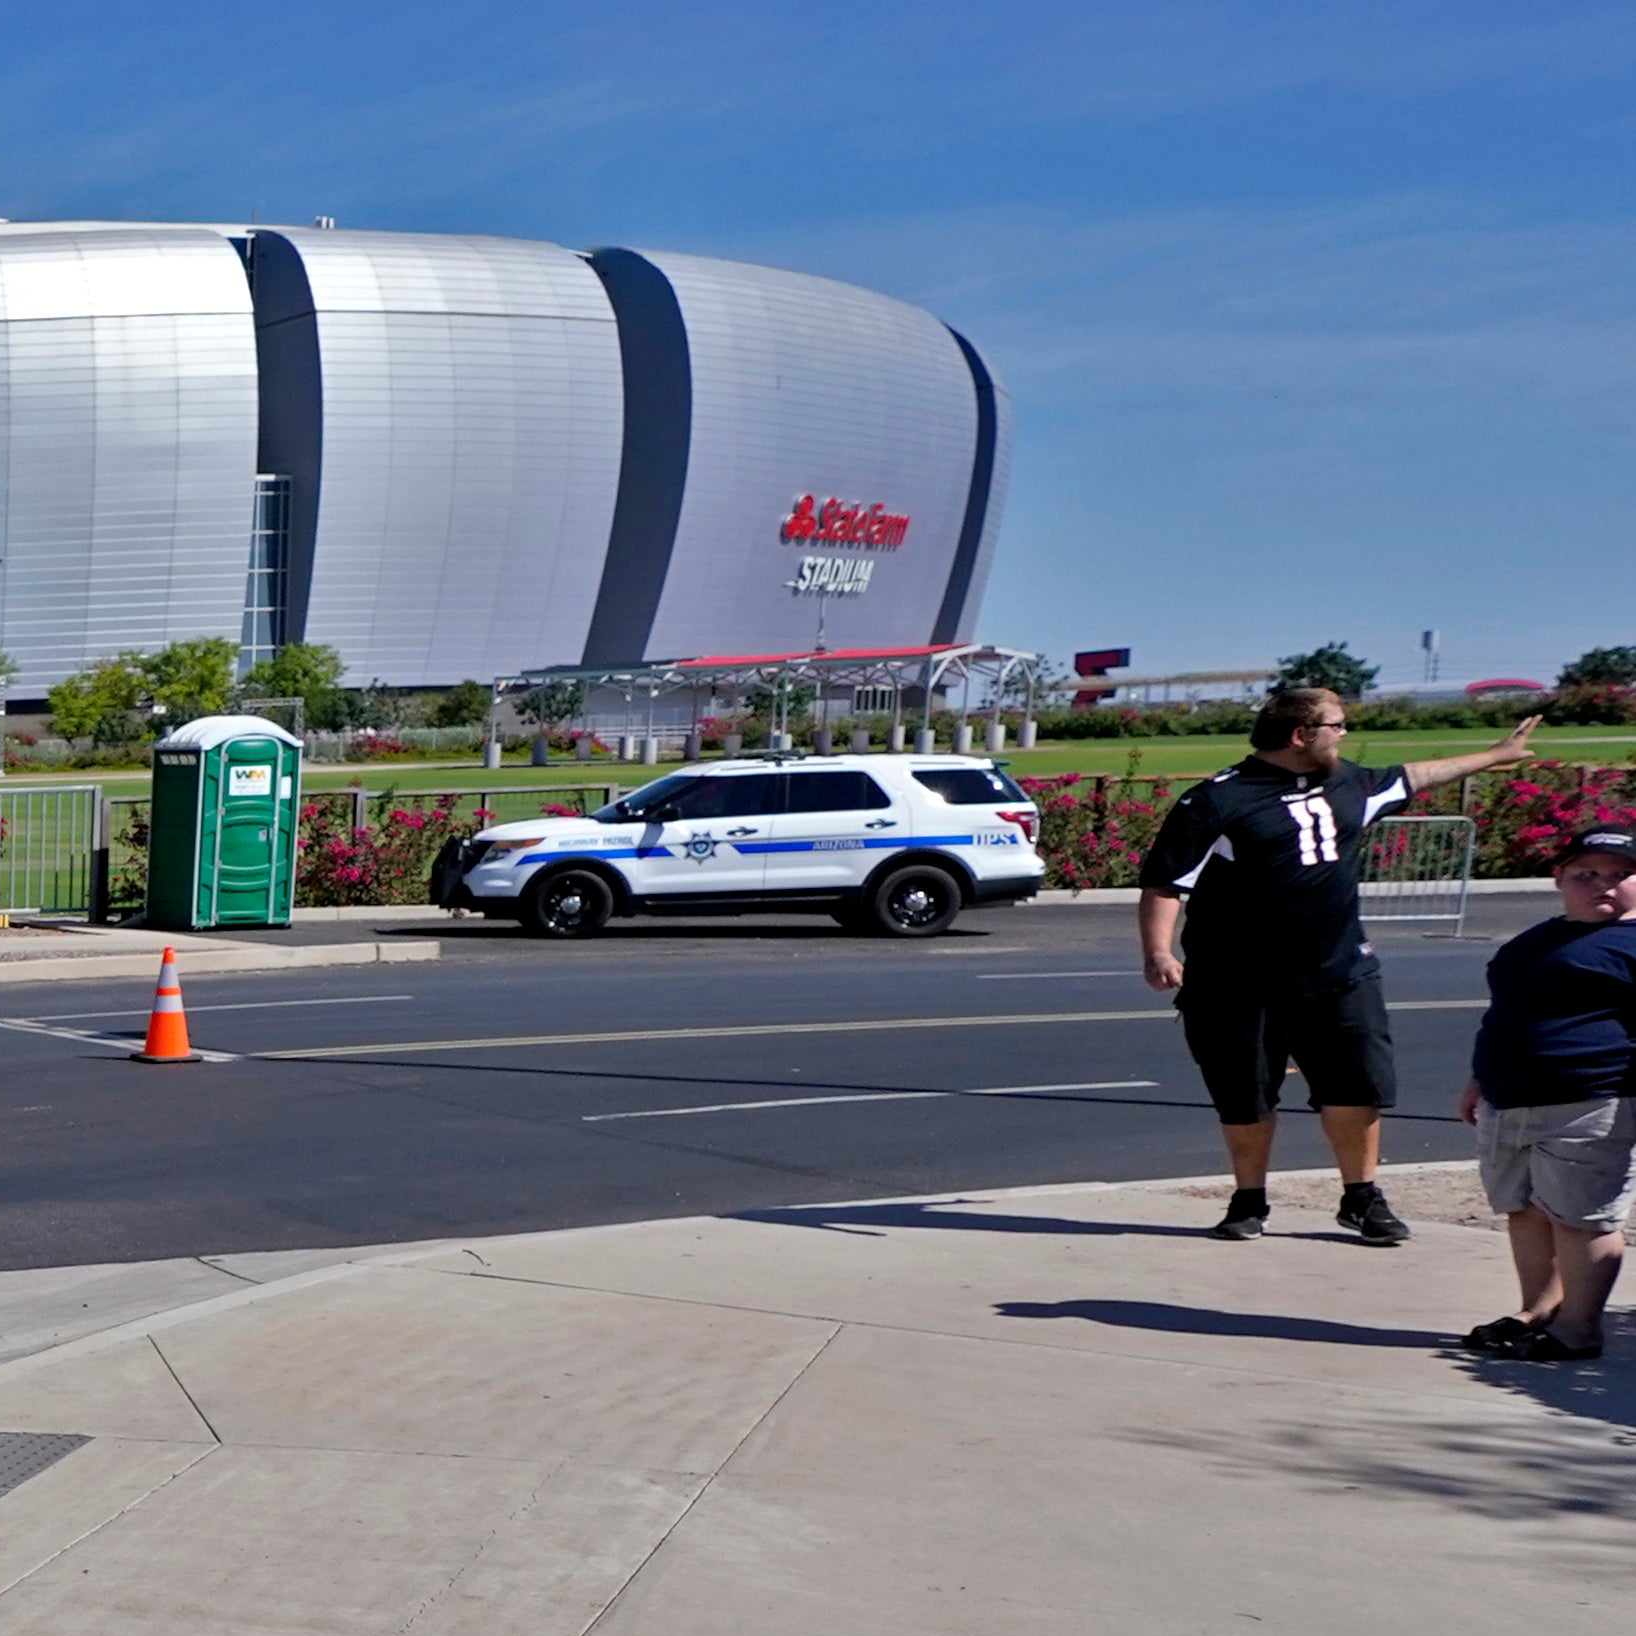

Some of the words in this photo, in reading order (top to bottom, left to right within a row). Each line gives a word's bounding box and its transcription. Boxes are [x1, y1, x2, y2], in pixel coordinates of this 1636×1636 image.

[798, 556, 875, 592] STADIUM
[812, 838, 865, 850] ARIZONA
[1288, 796, 1340, 866] 11
